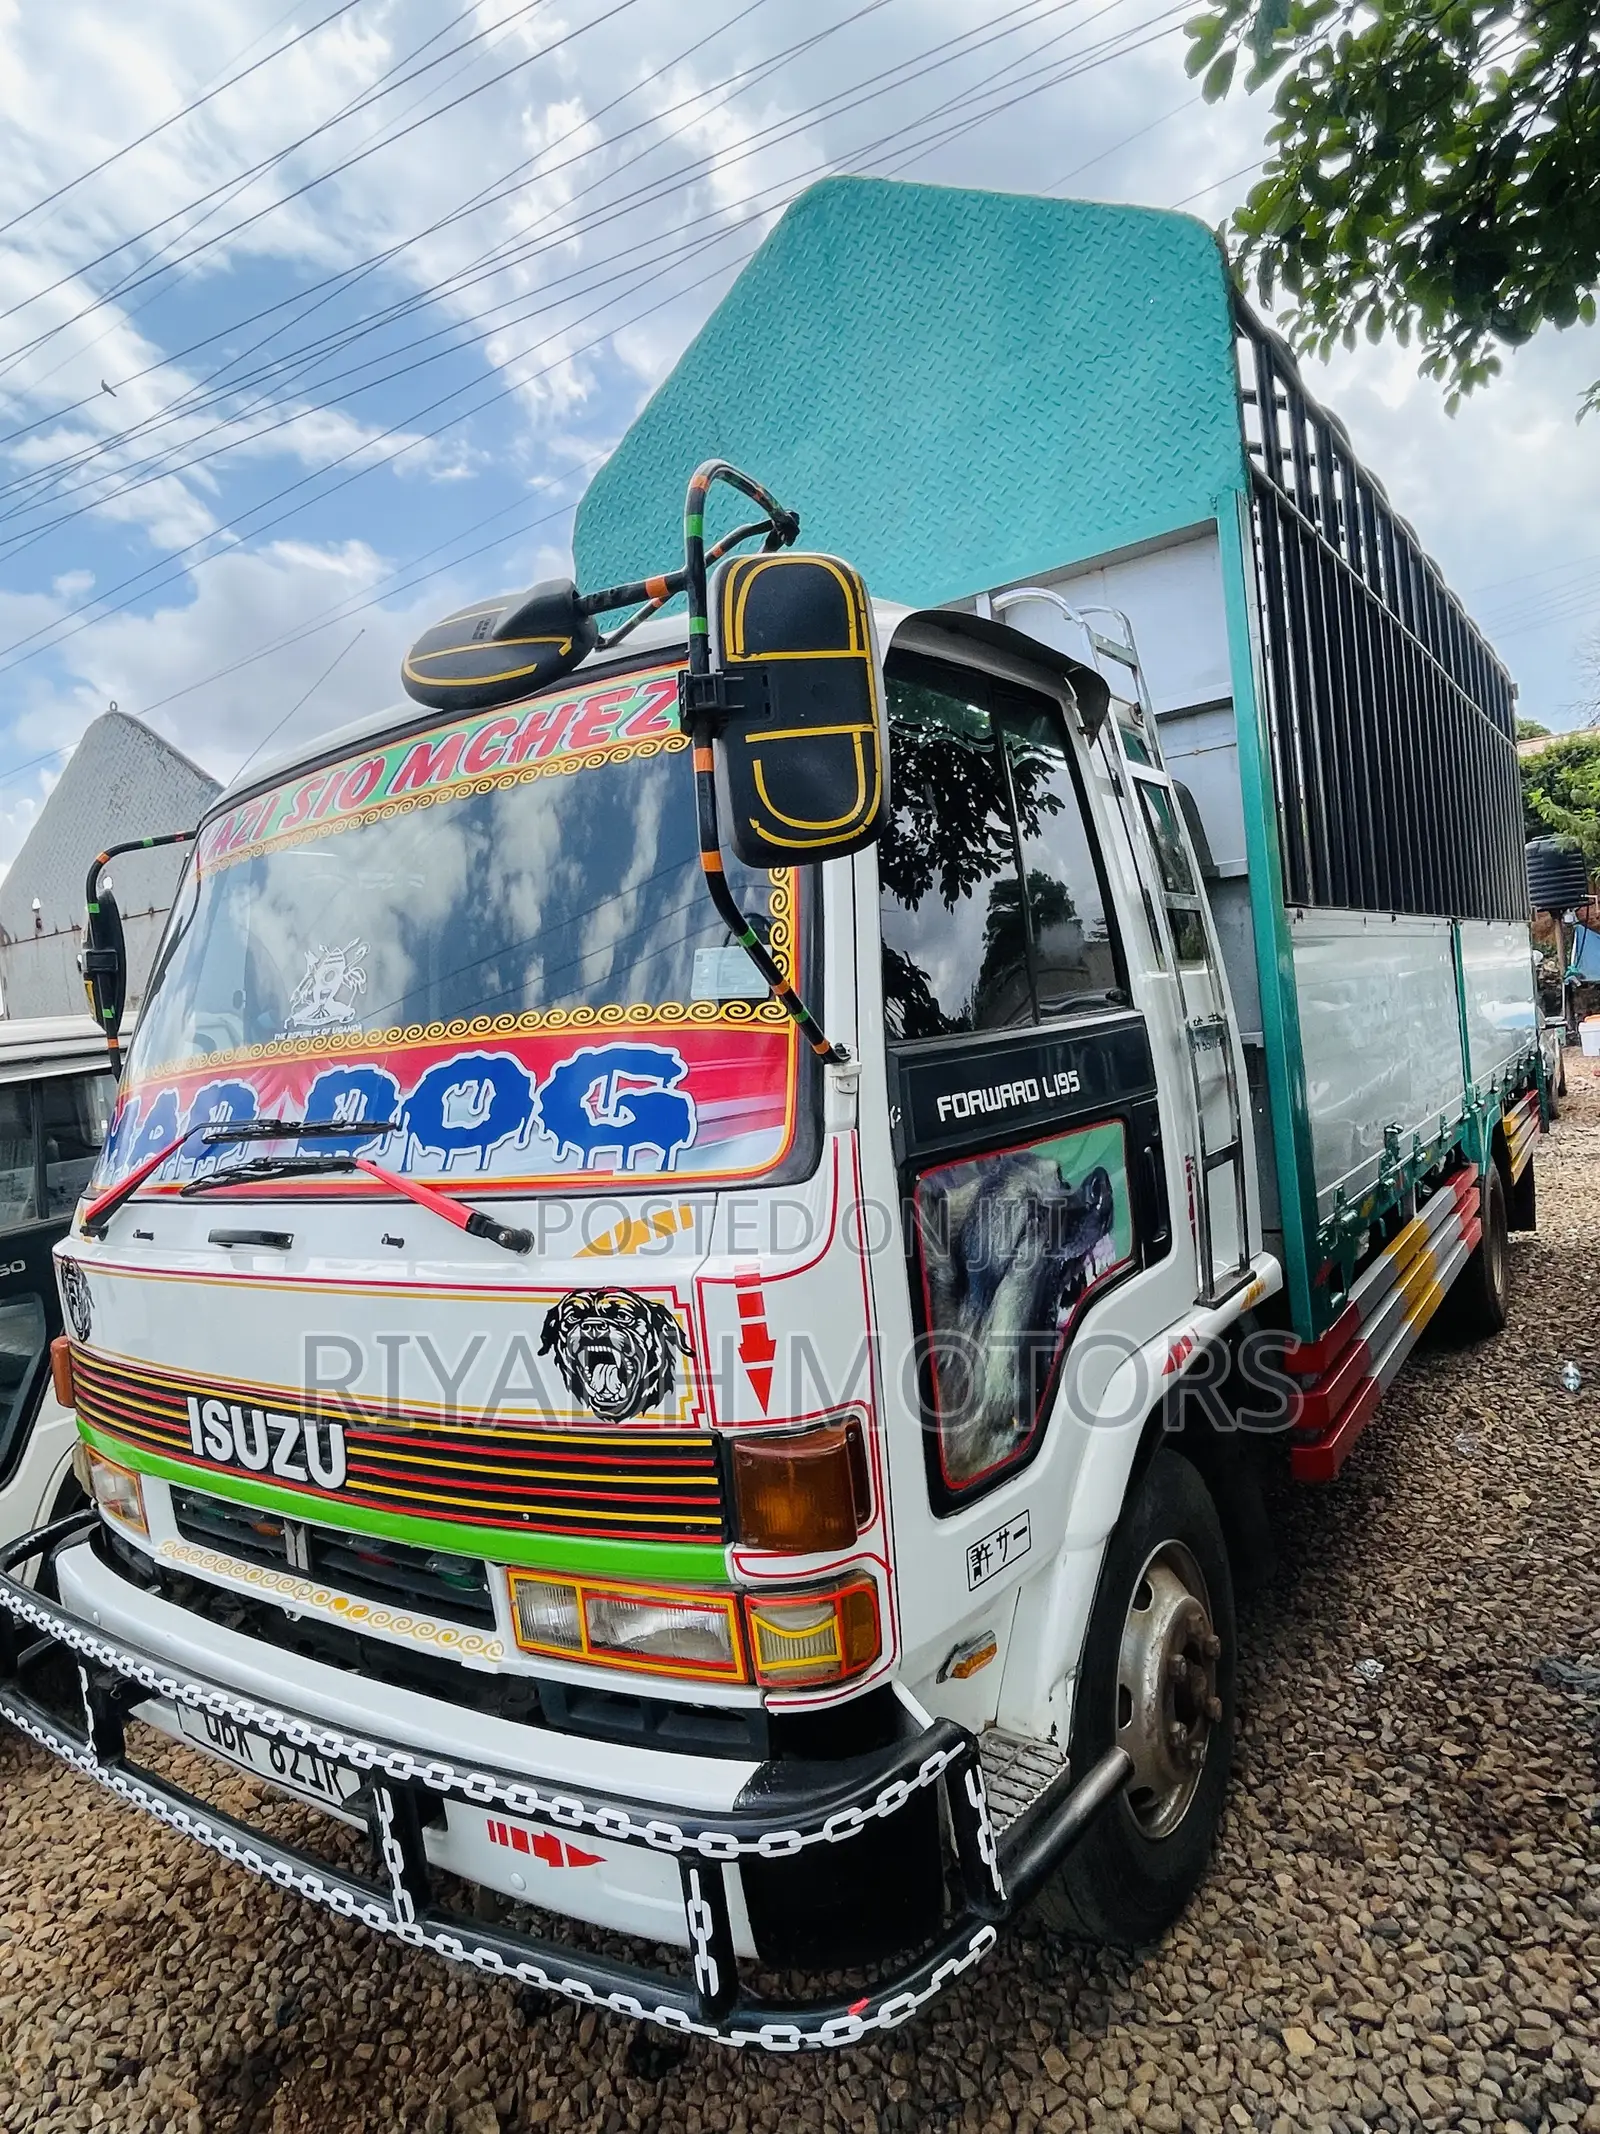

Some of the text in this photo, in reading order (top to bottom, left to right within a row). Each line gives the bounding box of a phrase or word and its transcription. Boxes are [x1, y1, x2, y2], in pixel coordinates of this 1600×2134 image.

[281, 755, 387, 831] SIO
[274, 1022, 363, 1041] THE REPUBLIC OF UGANDA
[297, 1042, 699, 1171] DOG
[936, 1069, 1081, 1122] FORWARD L195
[187, 1397, 347, 1489] ISUZU
